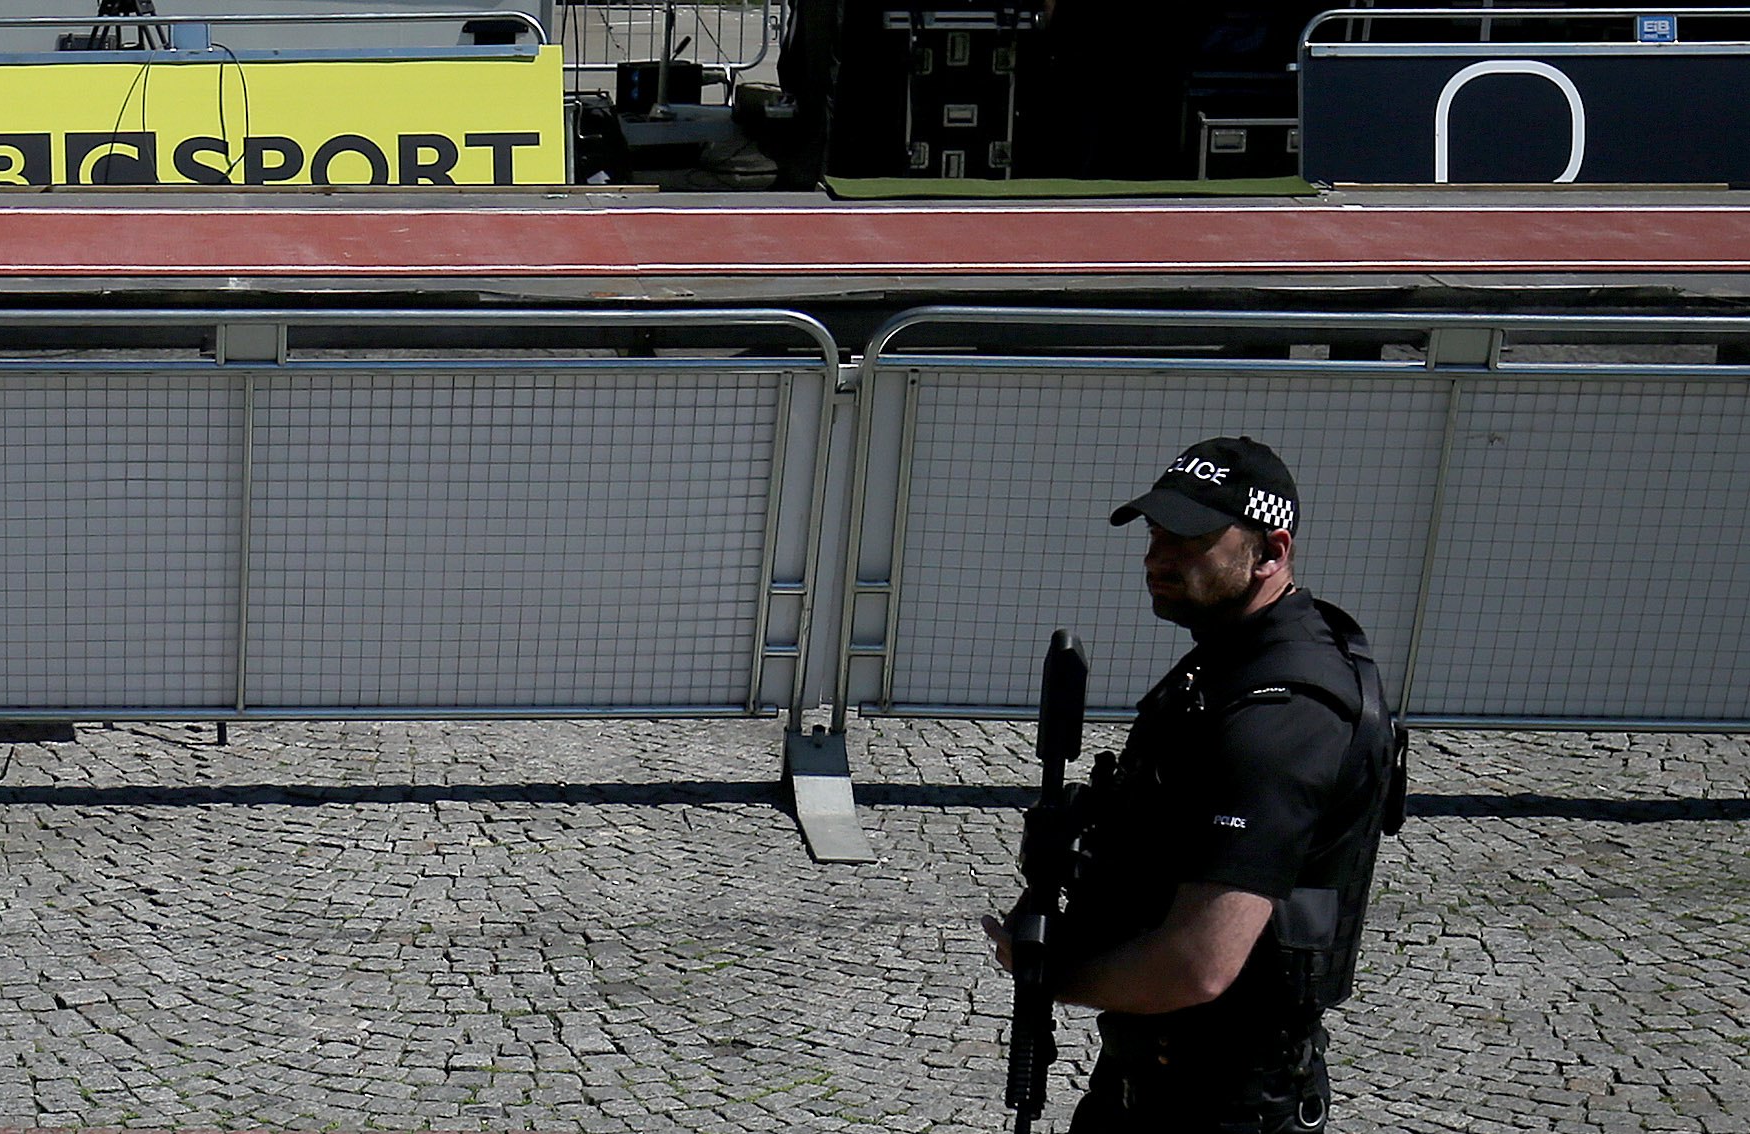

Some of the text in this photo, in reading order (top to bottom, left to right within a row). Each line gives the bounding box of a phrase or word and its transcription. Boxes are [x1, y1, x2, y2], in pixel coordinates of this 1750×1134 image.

[173, 133, 540, 185] SPORT
[1167, 454, 1230, 485] LICE
[1213, 815, 1247, 828] POLICE
